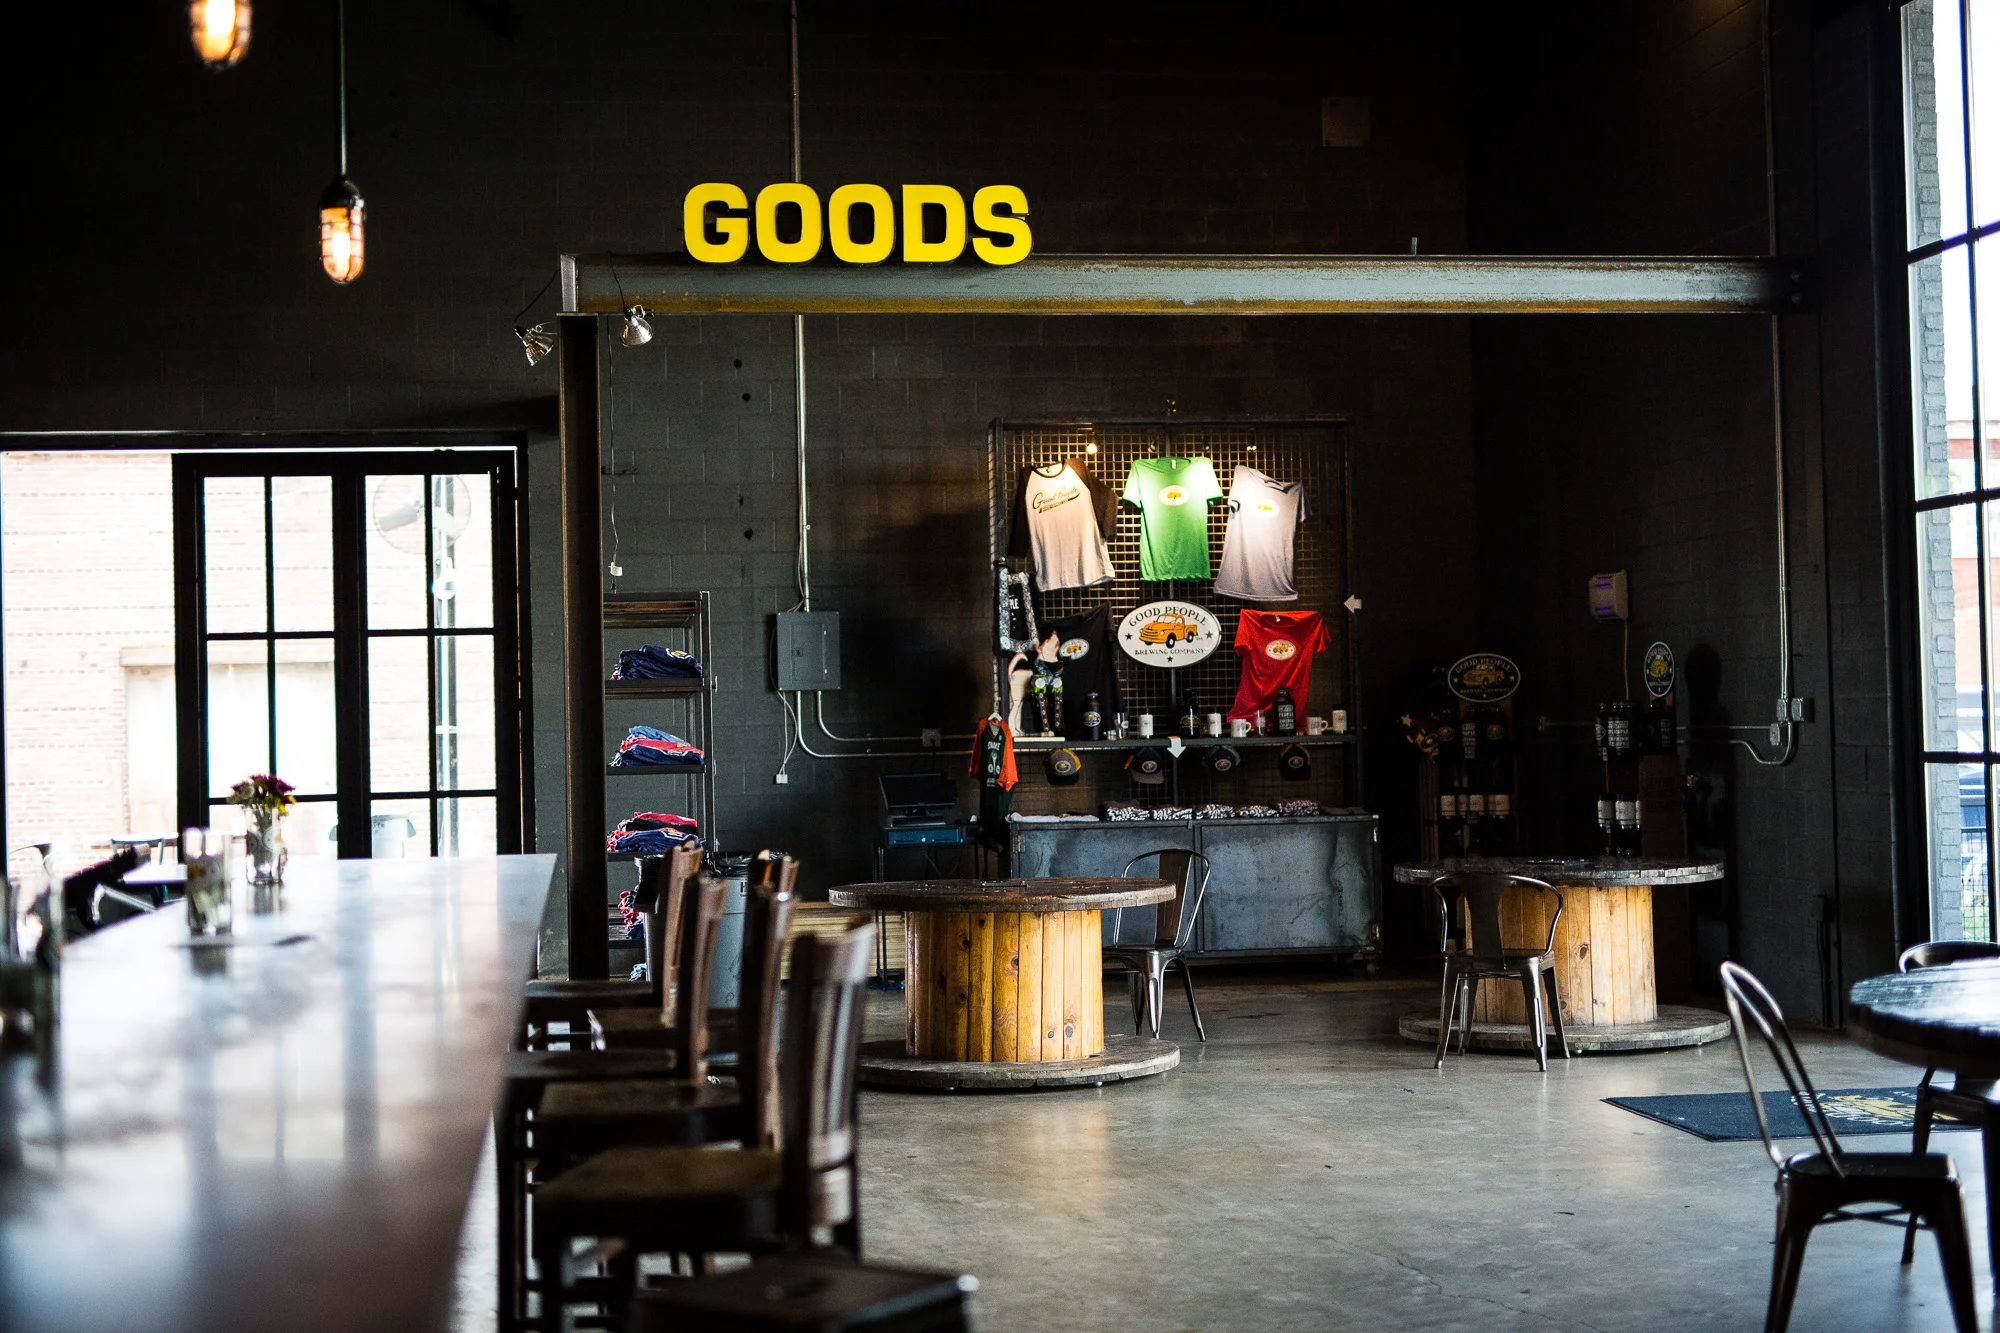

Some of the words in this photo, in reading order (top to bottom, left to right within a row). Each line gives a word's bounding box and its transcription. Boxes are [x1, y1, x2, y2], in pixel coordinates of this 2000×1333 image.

[683, 182, 1034, 266] GOODS
[1129, 607, 1161, 627] GOOD
[1165, 606, 1209, 626] PEOPLE
